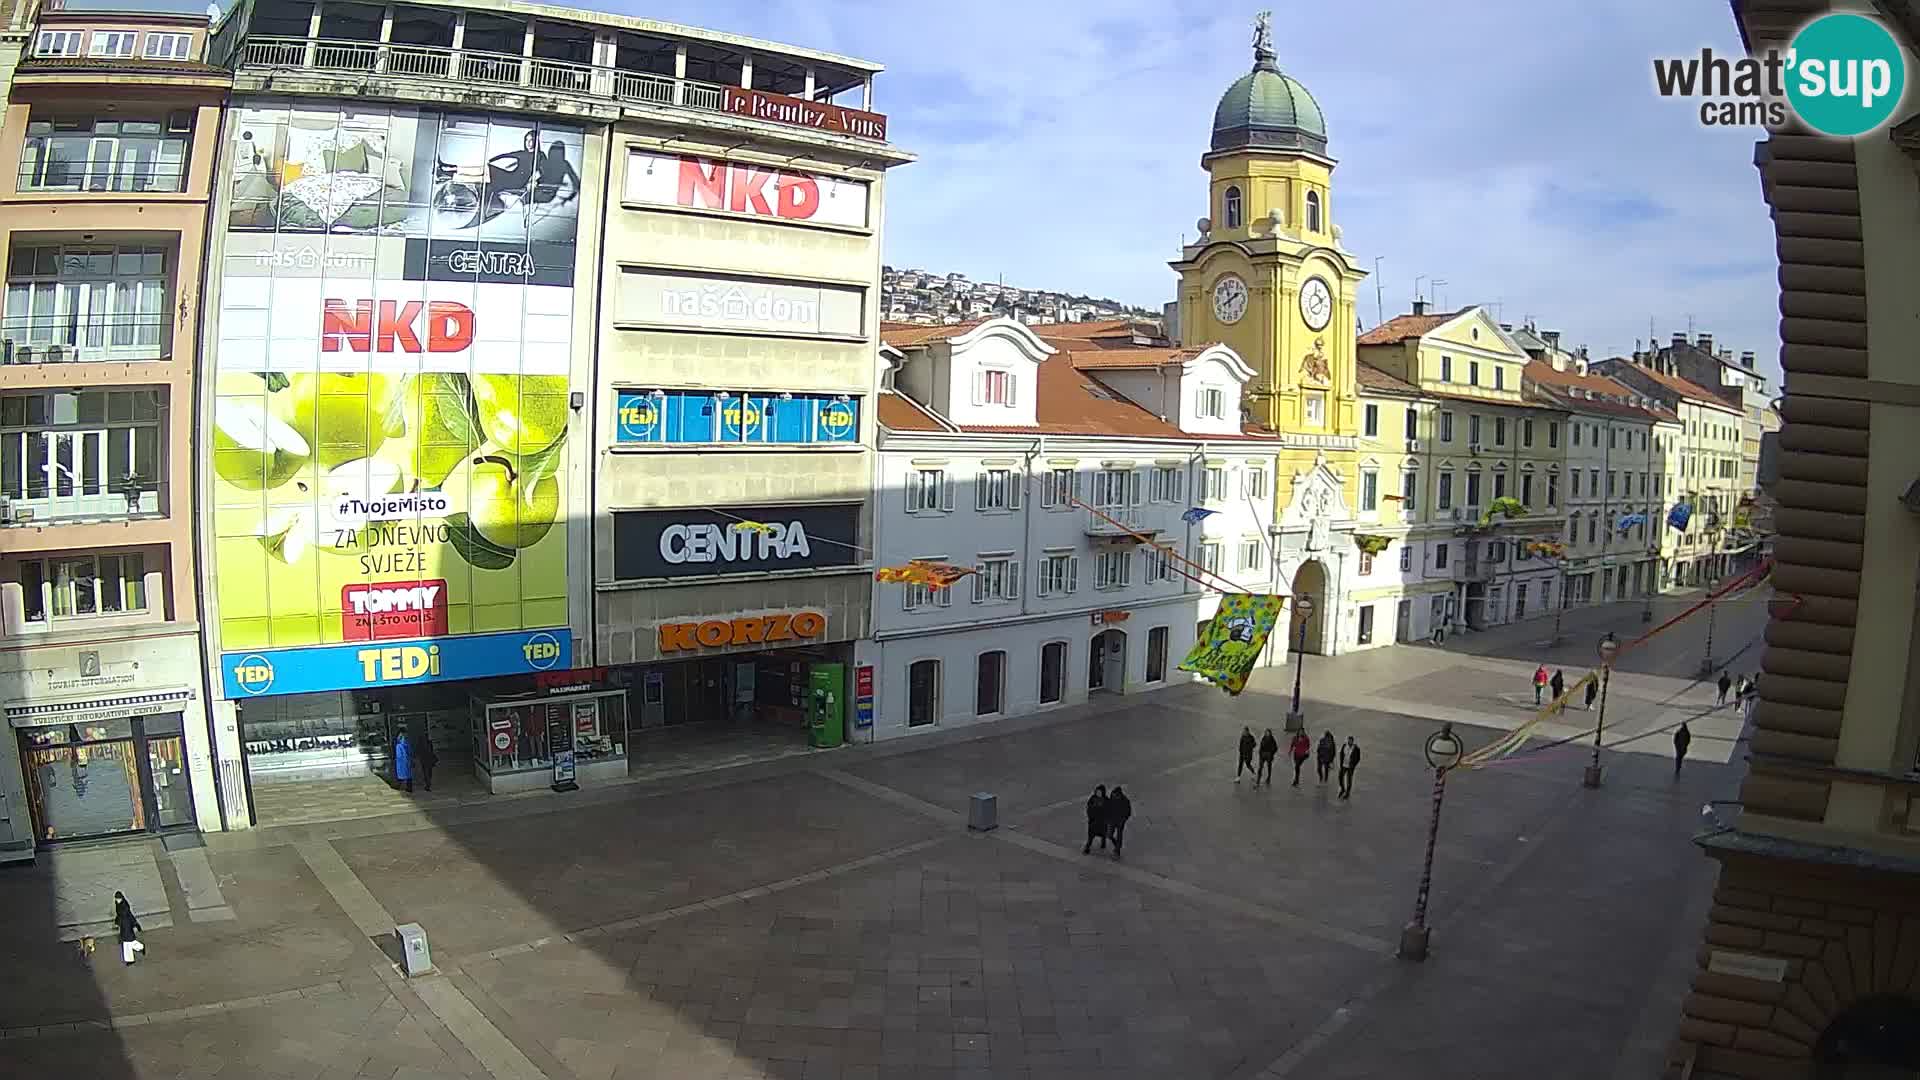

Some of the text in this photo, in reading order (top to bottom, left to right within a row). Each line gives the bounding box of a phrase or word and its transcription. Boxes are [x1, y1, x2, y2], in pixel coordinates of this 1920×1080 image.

[723, 89, 746, 113] Le
[678, 156, 820, 219] NKD
[448, 250, 536, 276] CENTRA
[662, 284, 818, 323] naš dom
[321, 298, 476, 353] NKD
[619, 408, 658, 425] TEDi
[339, 497, 446, 516] #TvojeMisto
[335, 524, 450, 549] ZA DNEVNO
[660, 520, 811, 564] CENTRA
[360, 547, 427, 574] SVJEŽE
[349, 586, 440, 614] TOMMY
[380, 613, 401, 626] ŠTO
[659, 612, 826, 652] KORZO
[358, 645, 440, 682] TEDi
[522, 642, 560, 660] TEDi
[234, 666, 275, 684] TEDi
[133, 705, 163, 715] CENTAR
